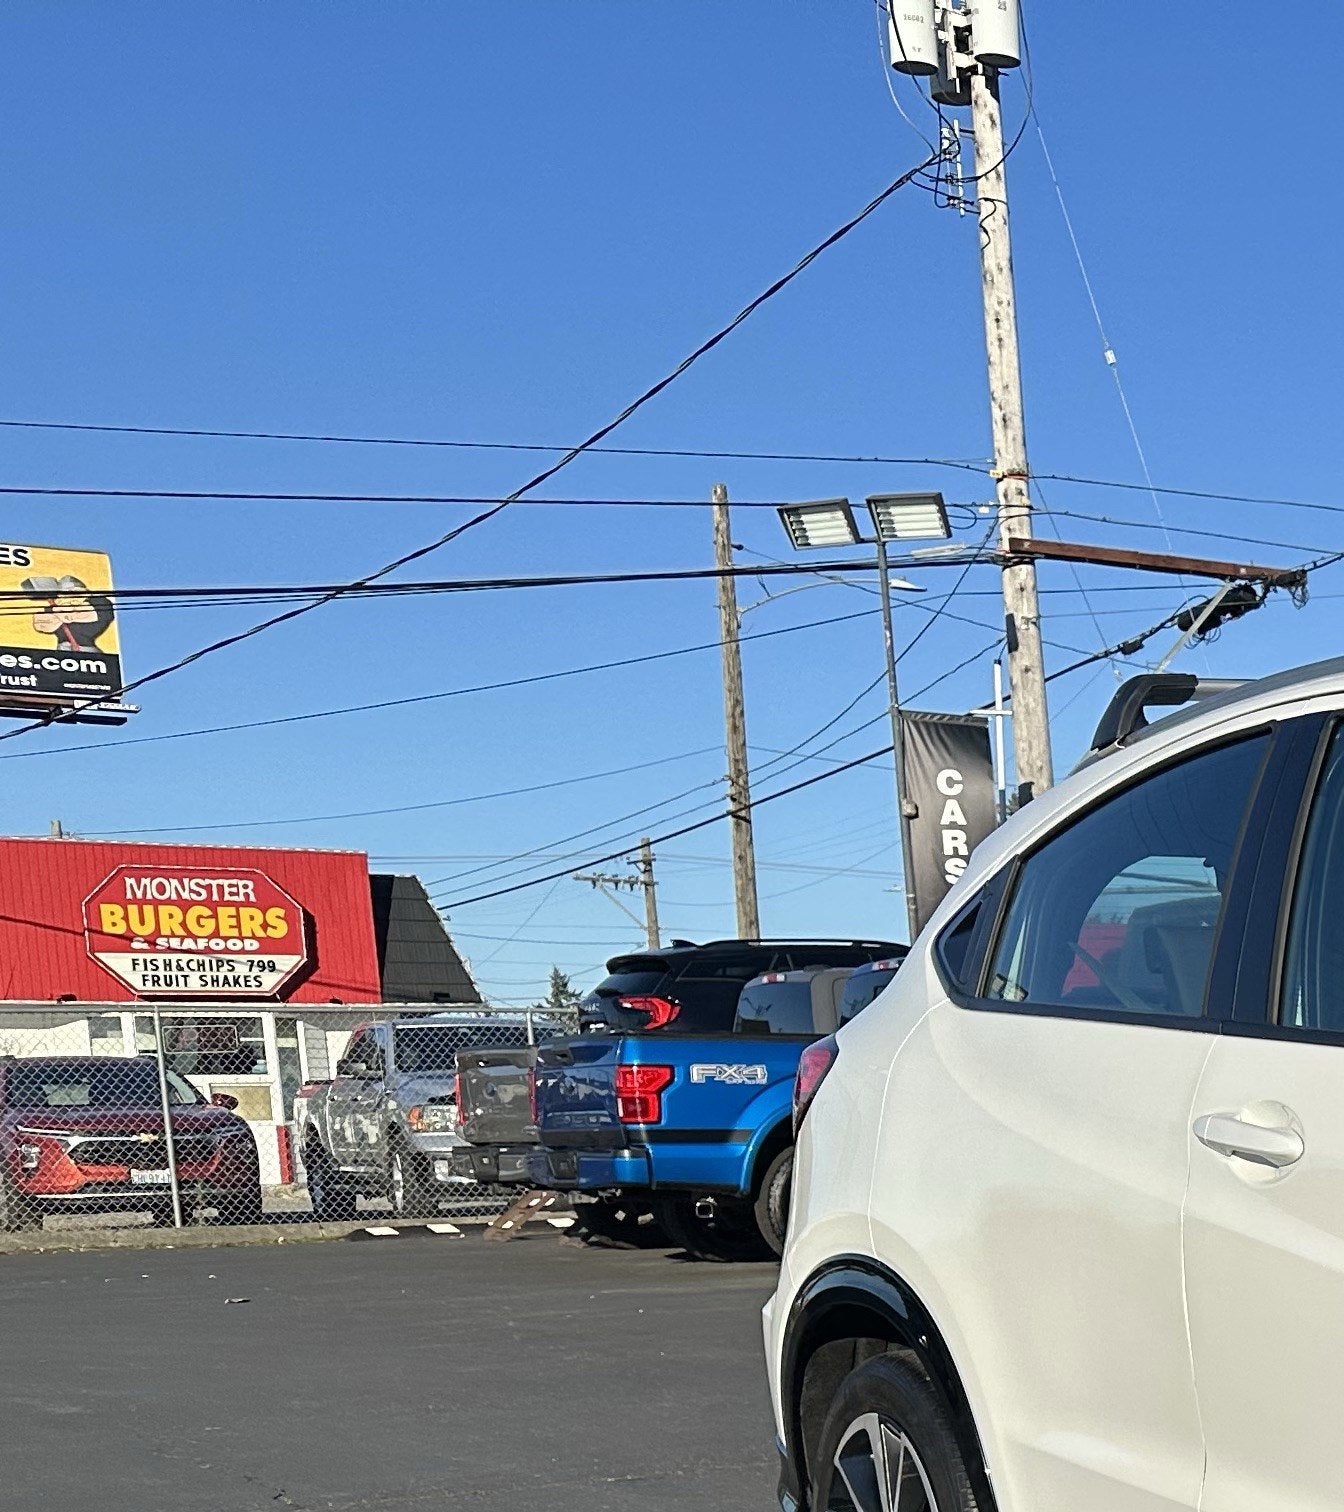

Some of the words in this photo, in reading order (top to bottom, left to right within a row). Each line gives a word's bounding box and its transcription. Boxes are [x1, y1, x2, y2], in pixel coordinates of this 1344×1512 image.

[0, 653, 107, 674] es.com
[0, 674, 38, 687] rust
[936, 769, 969, 885] CARS
[124, 876, 257, 902] MONSTER
[100, 903, 288, 939] BURGERS
[130, 938, 151, 950] &
[155, 937, 261, 951] SEAFOOD
[246, 959, 277, 973] 799
[141, 974, 190, 988] FRUIT
[200, 974, 263, 988] SHAKES
[690, 1063, 768, 1083] FX4
